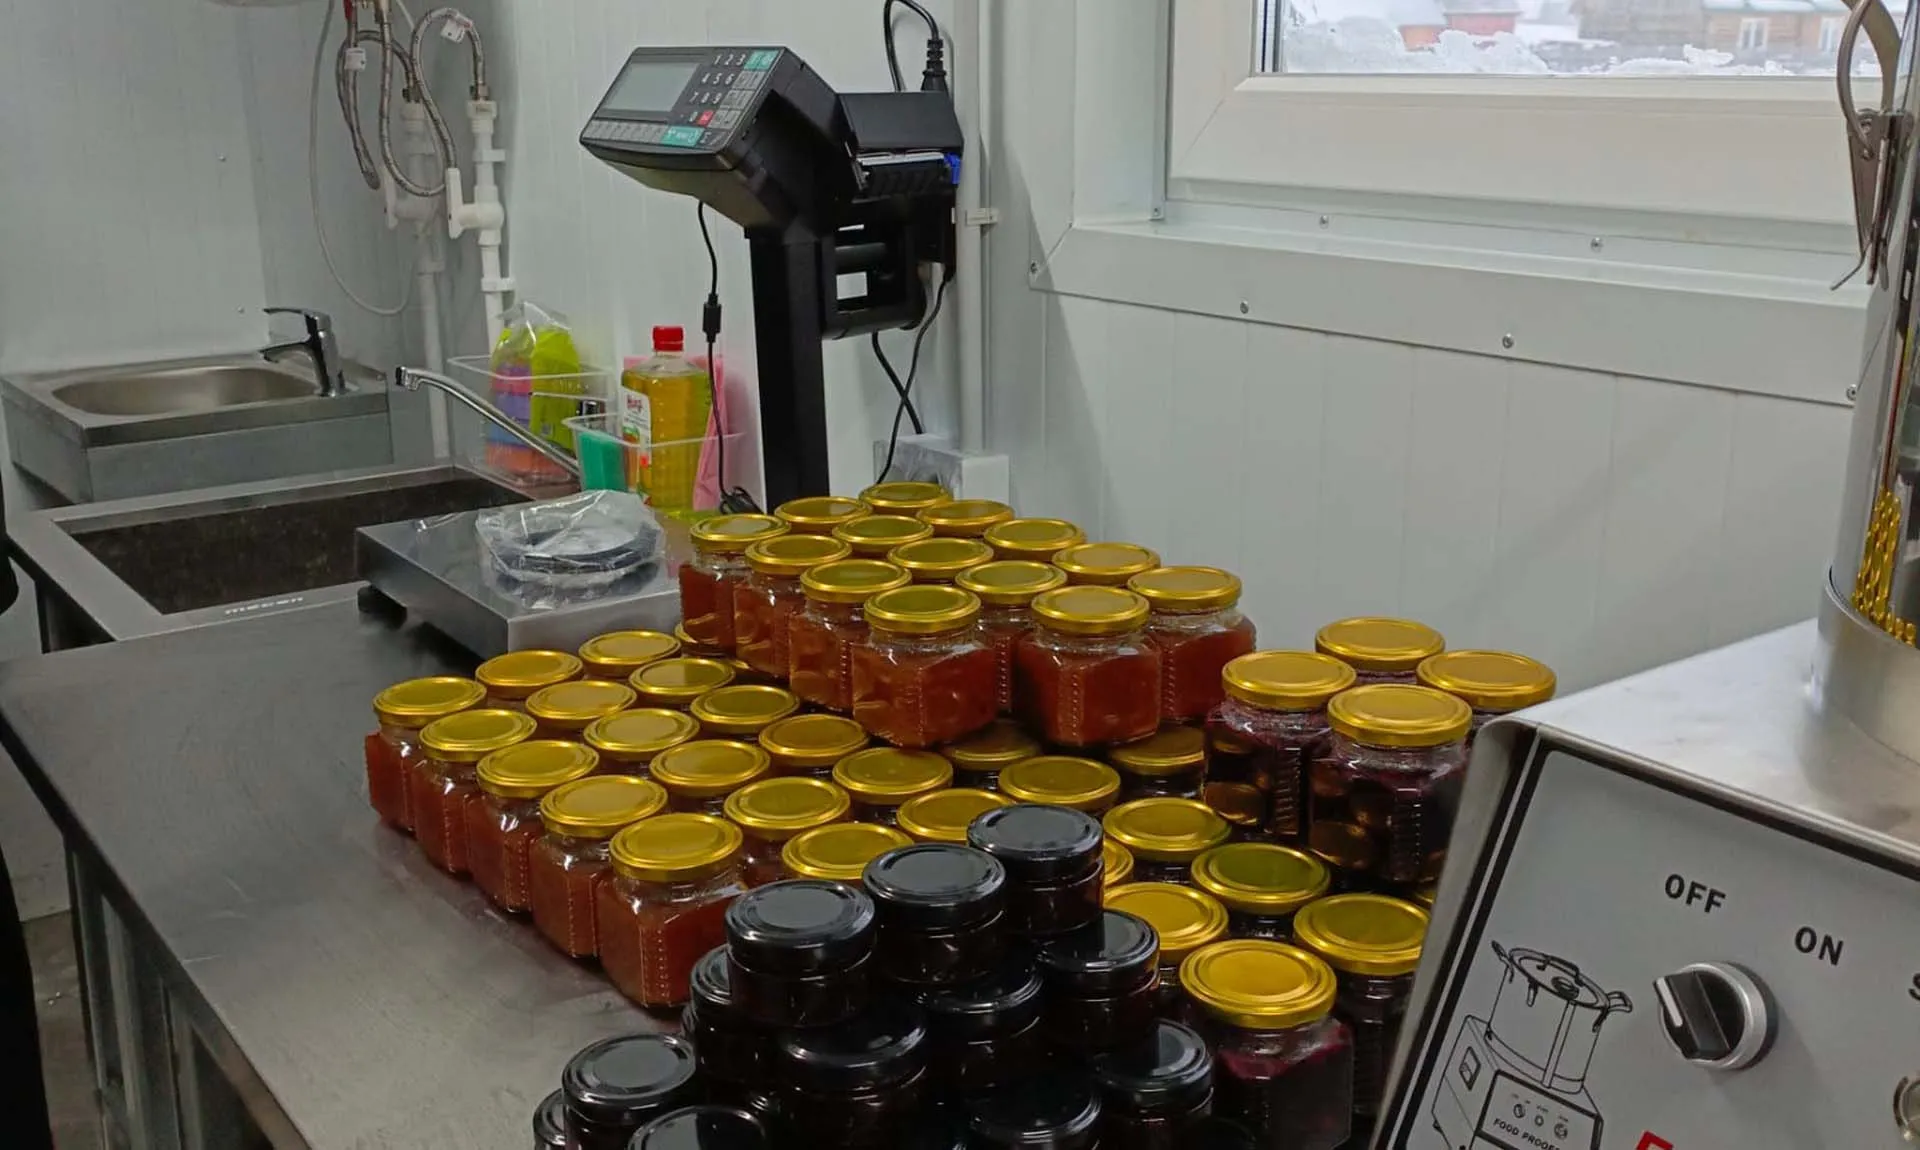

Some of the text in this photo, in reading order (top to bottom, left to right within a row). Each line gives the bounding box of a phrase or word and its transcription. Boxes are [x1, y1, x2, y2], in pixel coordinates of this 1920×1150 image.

[1664, 873, 1727, 914] OFF
[1794, 925, 1845, 966] ON
[1493, 1117, 1520, 1136] FOOD
